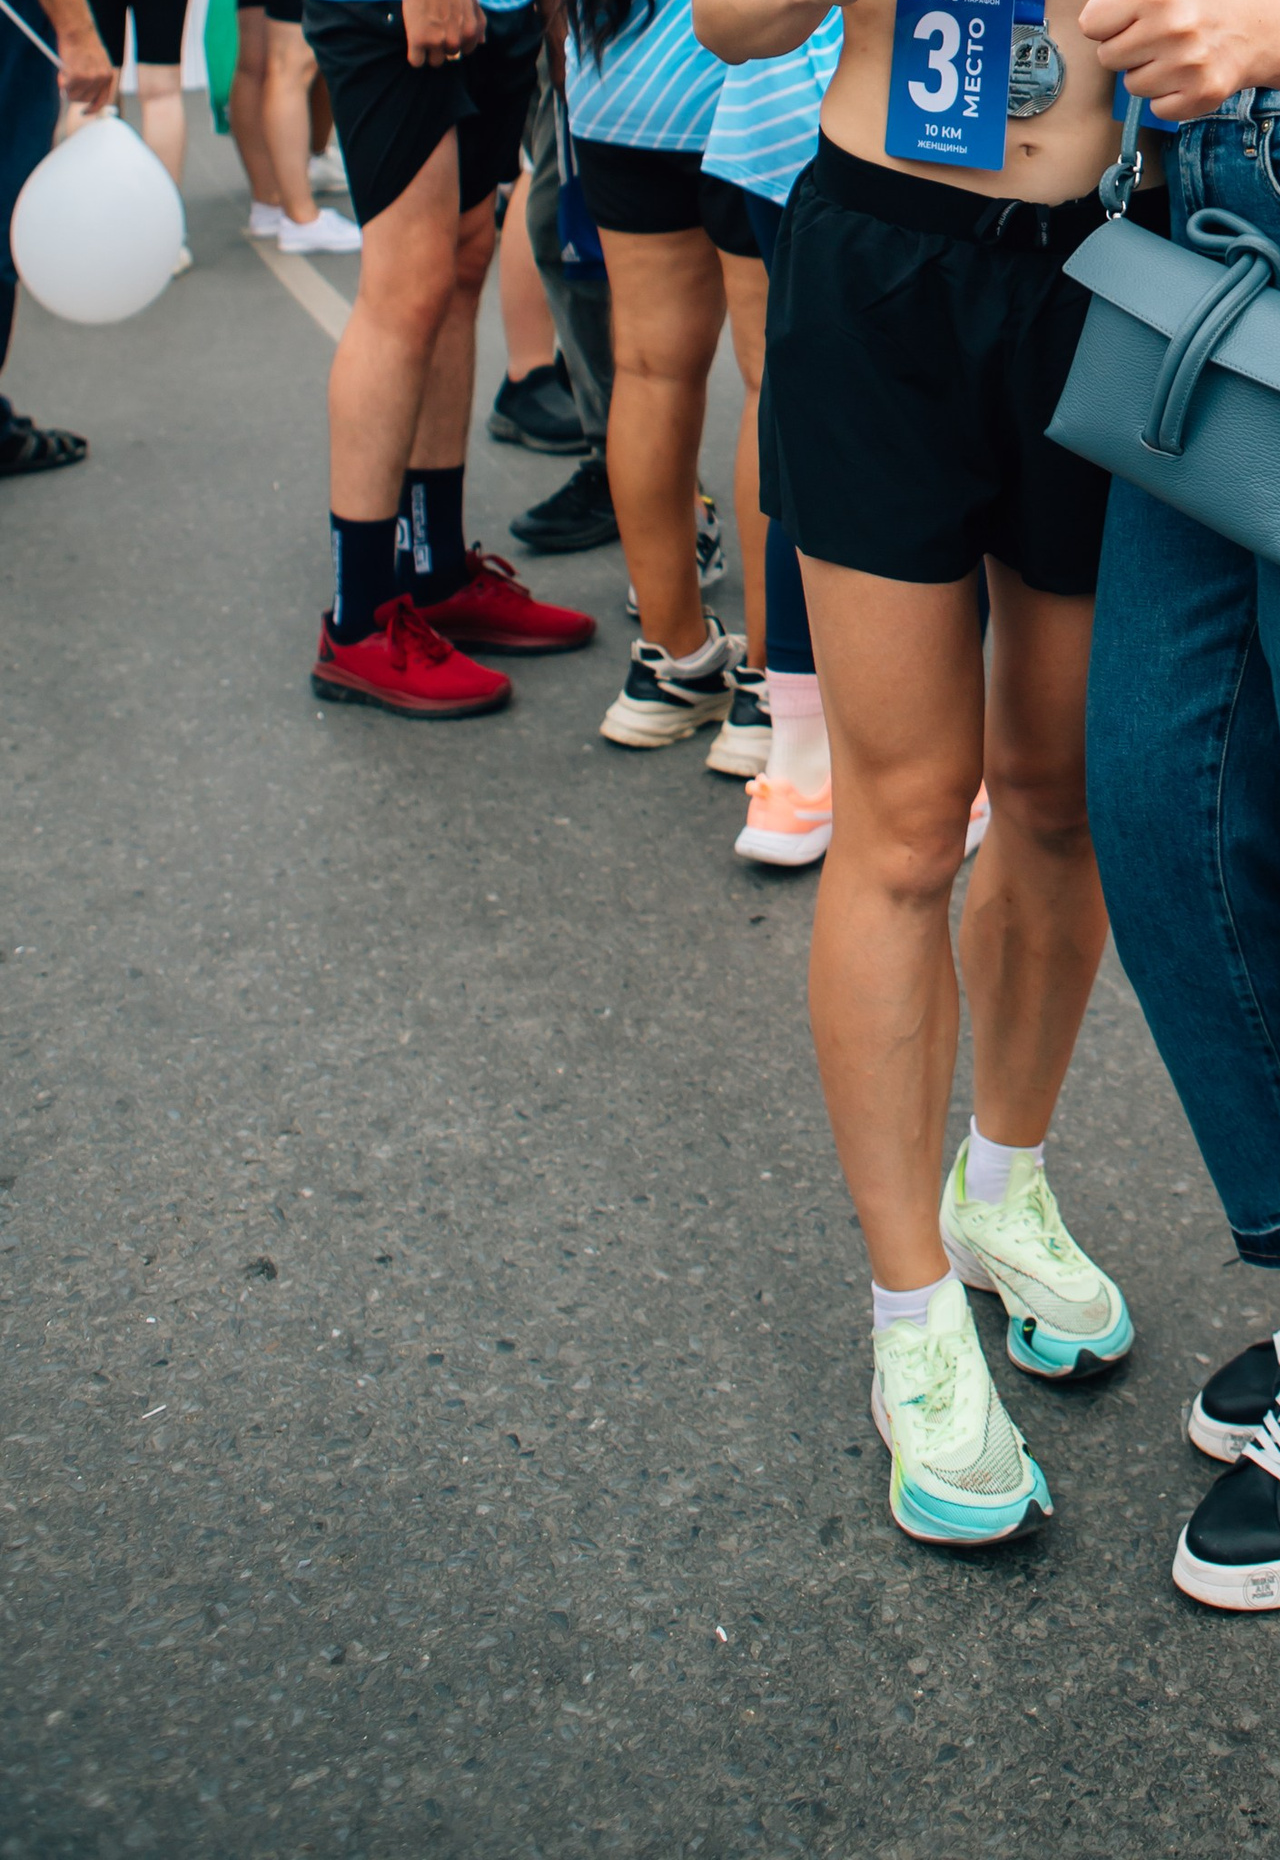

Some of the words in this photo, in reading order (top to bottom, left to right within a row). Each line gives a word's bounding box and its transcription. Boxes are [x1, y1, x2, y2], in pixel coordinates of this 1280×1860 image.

[907, 10, 961, 113] 3
[962, 17, 985, 118] МЕСТО
[917, 139, 968, 155] ЖЕНЩИНЫ
[924, 123, 939, 137] 10
